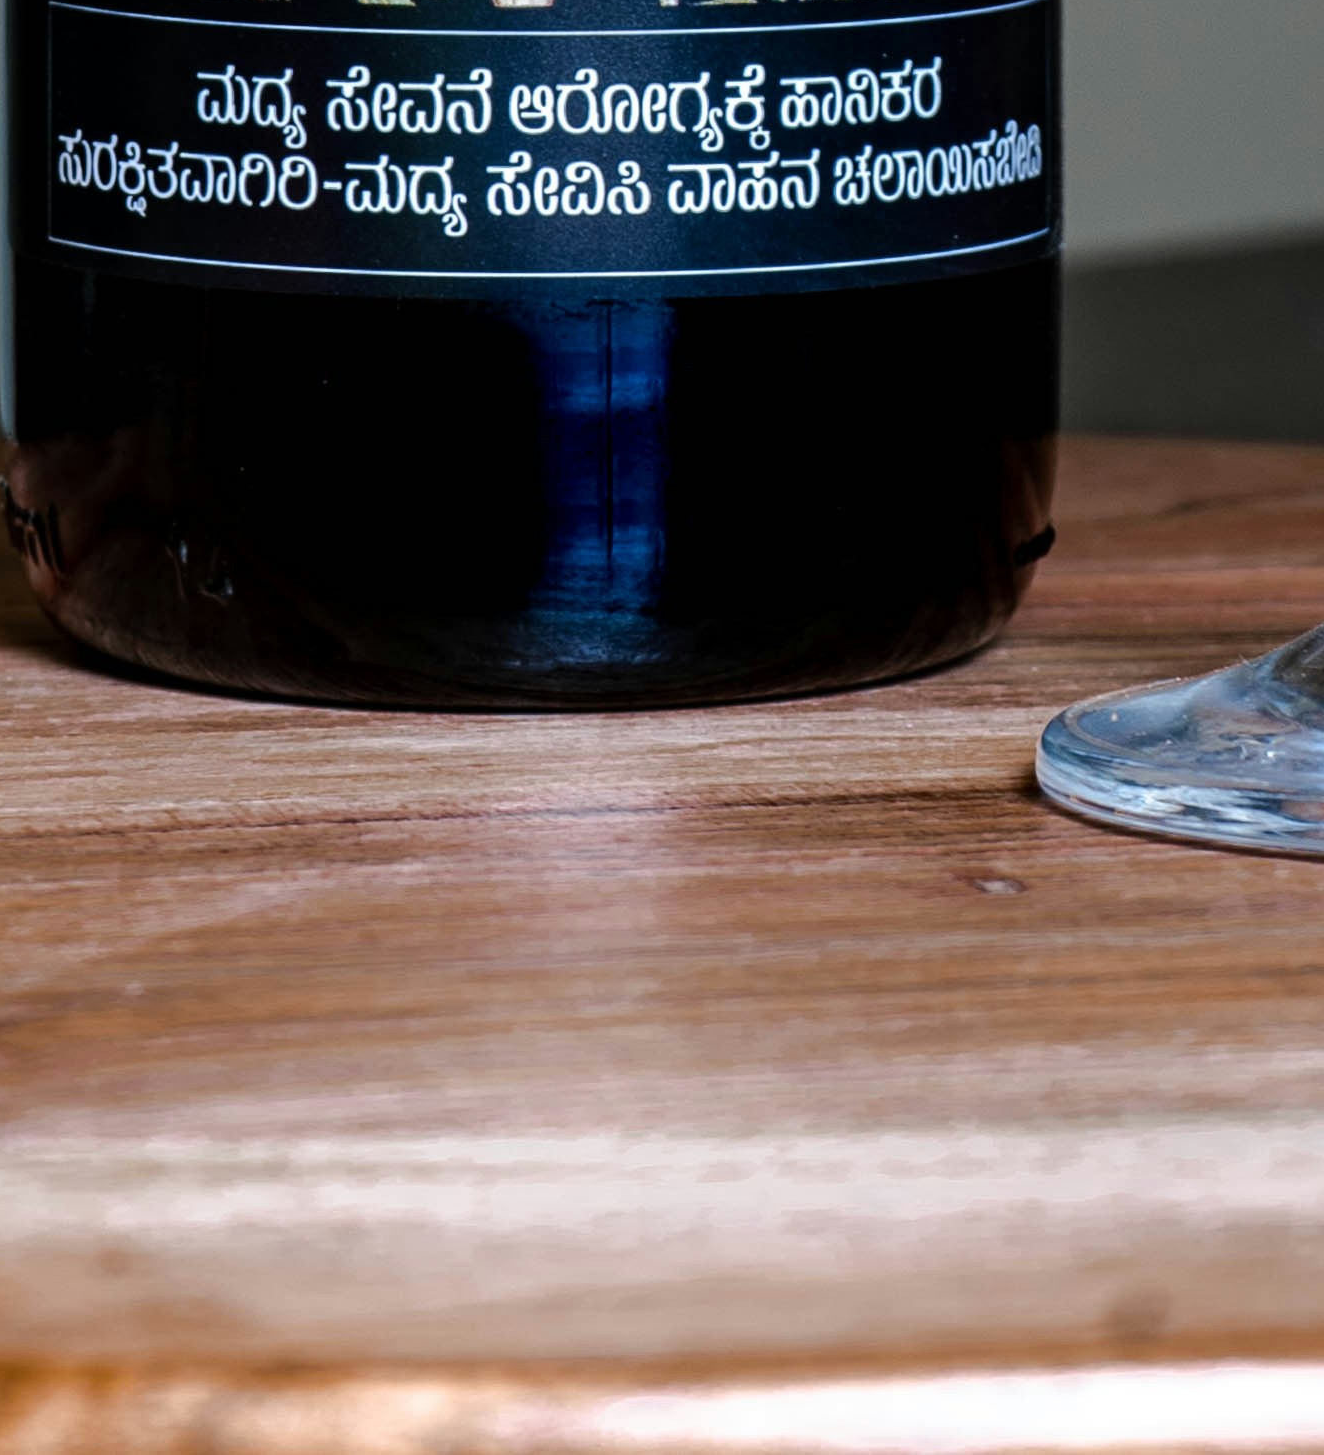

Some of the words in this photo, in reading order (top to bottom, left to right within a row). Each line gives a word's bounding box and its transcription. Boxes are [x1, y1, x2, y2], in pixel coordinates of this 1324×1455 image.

[196, 64, 307, 149] ಮದ್ಯ
[325, 64, 493, 134] ಸೇವನೆ
[507, 63, 772, 152] ಆರೋಗ್ಯಕ್ಕೆ
[779, 55, 943, 128] ಹಾನಿಕರ
[485, 150, 653, 216] ಸೇವಿಸಿ
[667, 147, 822, 214] ವಾಹನ
[833, 118, 1043, 206] ಚಲಾಯಿಸಬೇಡಿ
